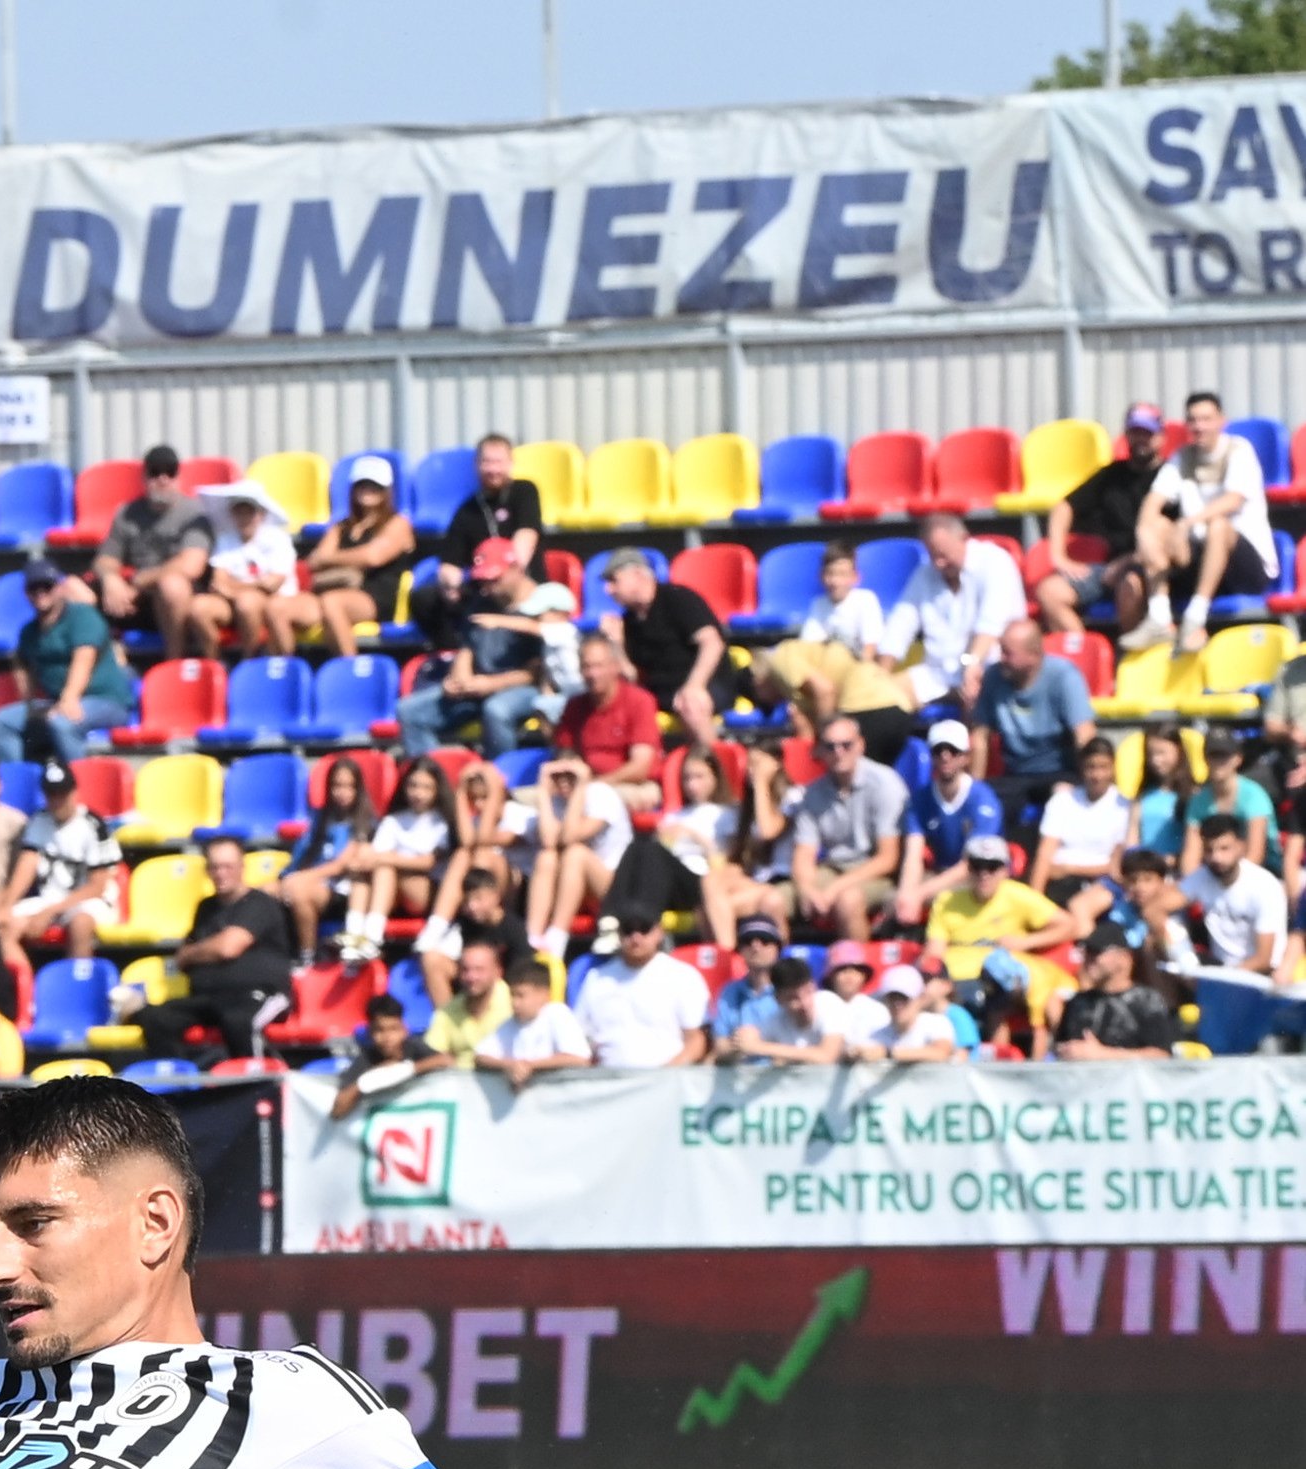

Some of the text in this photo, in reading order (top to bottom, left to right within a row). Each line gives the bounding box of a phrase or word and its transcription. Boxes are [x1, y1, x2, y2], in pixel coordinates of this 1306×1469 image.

[11, 160, 1051, 339] DUMNEZEU
[1150, 229, 1239, 296] TO
[681, 1104, 886, 1147] ECHIPAJE
[903, 1100, 1129, 1144] MEDICALE
[765, 1171, 933, 1214] PENTRU
[950, 1170, 1085, 1212] ORICE
